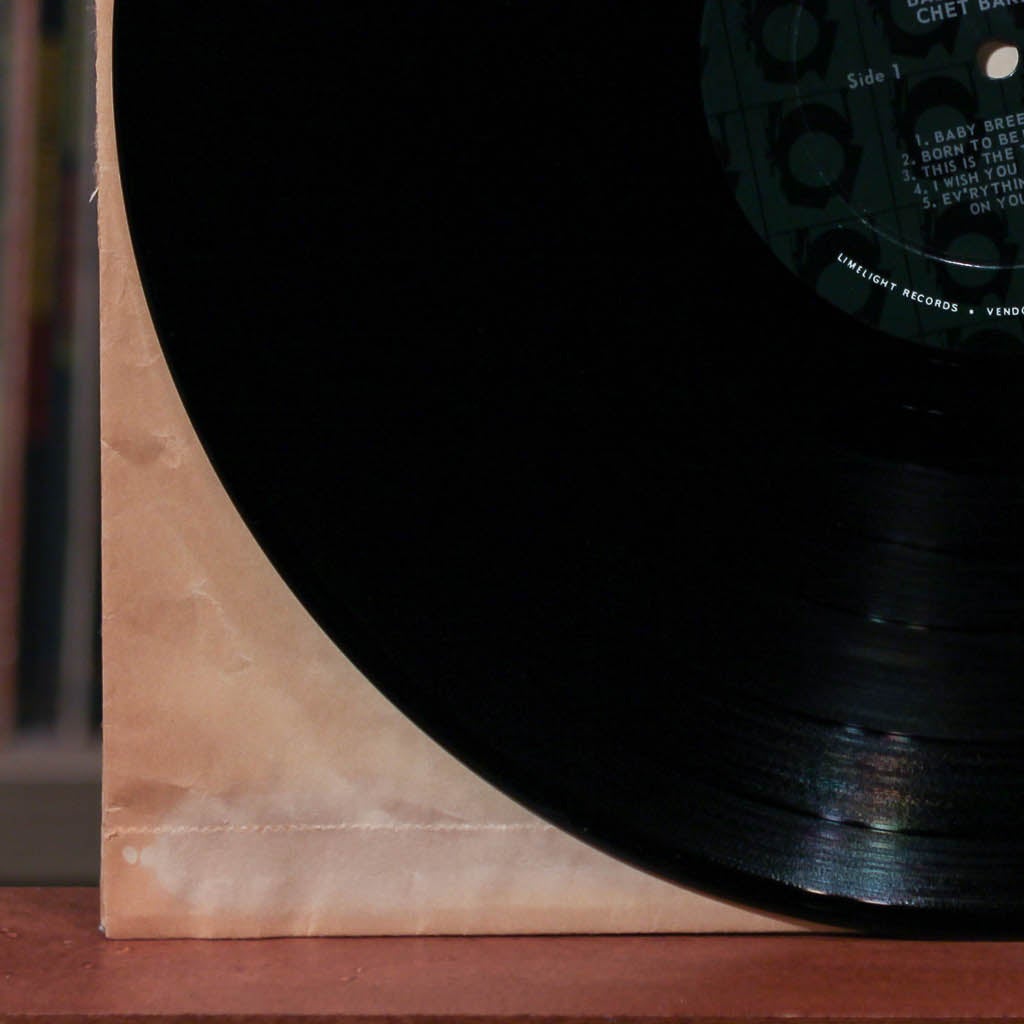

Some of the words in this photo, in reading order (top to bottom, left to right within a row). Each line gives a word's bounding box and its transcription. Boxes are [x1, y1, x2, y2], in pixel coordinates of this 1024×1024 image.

[917, 0, 968, 24] CHET
[848, 67, 885, 89] Side
[892, 64, 901, 80] 1
[915, 134, 929, 146] 1.
[935, 124, 975, 144] BABY
[902, 154, 915, 166] 2.
[922, 144, 964, 163] BORN
[970, 137, 992, 151] TO
[999, 131, 1019, 145] BE
[903, 169, 916, 181] 3.
[922, 160, 957, 177] THIS
[963, 155, 976, 168] IS
[983, 148, 1014, 165] THE
[913, 184, 928, 195] 4.
[933, 180, 938, 191] I
[944, 171, 980, 189] WISH
[984, 163, 1017, 181] YOU
[923, 197, 936, 209] 5.
[970, 201, 991, 215] ON
[837, 252, 897, 291] LIMELIGHT
[902, 288, 959, 312] RECORDS
